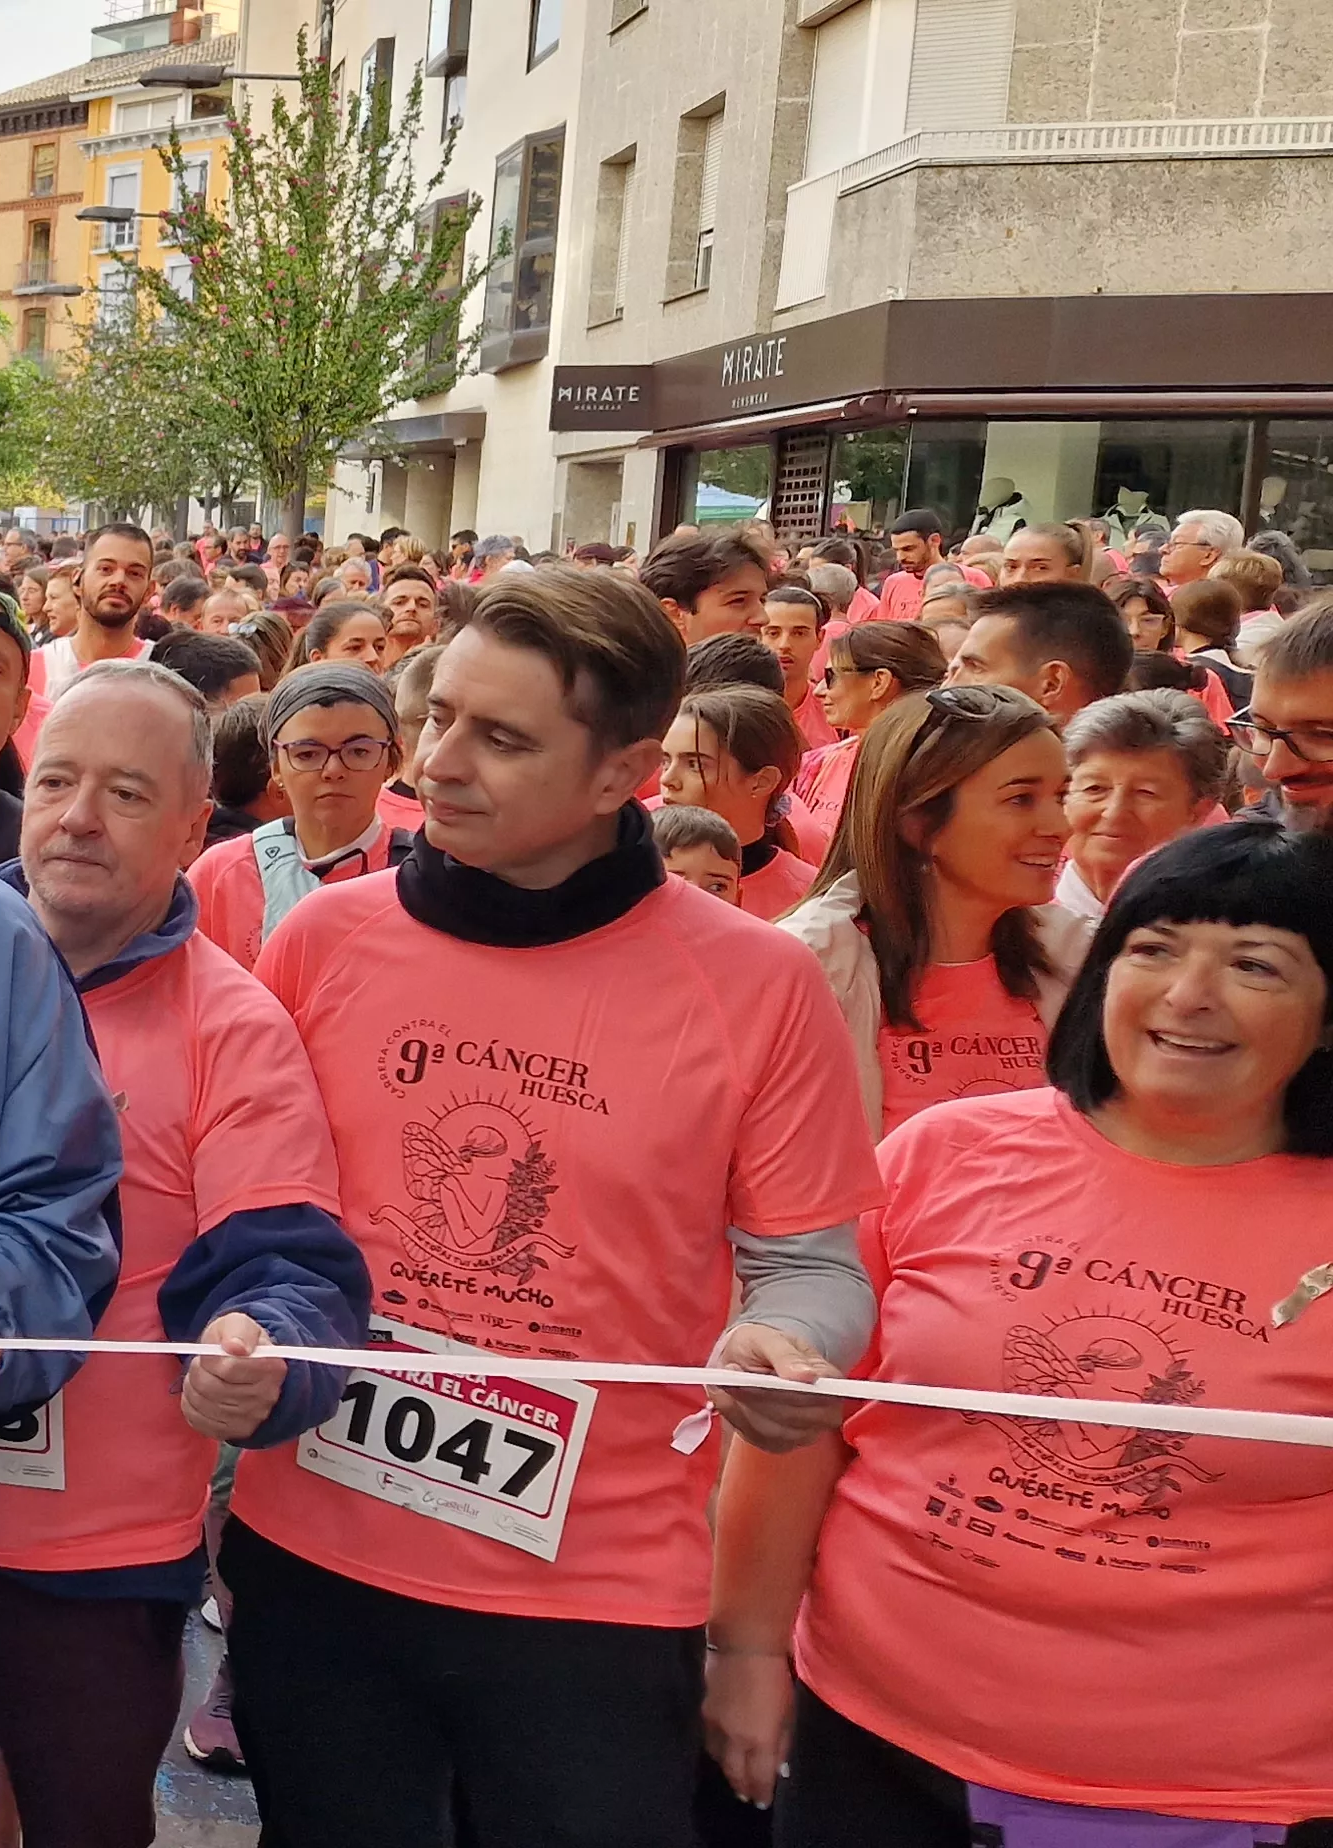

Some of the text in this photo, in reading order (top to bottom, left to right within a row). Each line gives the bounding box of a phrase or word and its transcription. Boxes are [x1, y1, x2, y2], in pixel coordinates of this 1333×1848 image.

[722, 337, 787, 388] MIRATE
[558, 386, 640, 402] MIRATE
[377, 1018, 452, 1099] CARRERA CONTRA EL
[456, 1040, 590, 1090] CÁNCER
[950, 1032, 1041, 1056] CÁNCER
[998, 1055, 1041, 1069] HUE
[519, 1078, 610, 1116] HUESCA
[390, 1261, 554, 1308] QUIÉRETE MUCHO
[1084, 1261, 1247, 1314] CÁNCER
[1161, 1298, 1270, 1343] HUESCA
[440, 1377, 464, 1399] EL
[471, 1389, 560, 1431] CÁNCER
[340, 1380, 557, 1498] 1047
[988, 1466, 1096, 1509] QUIÉRETE
